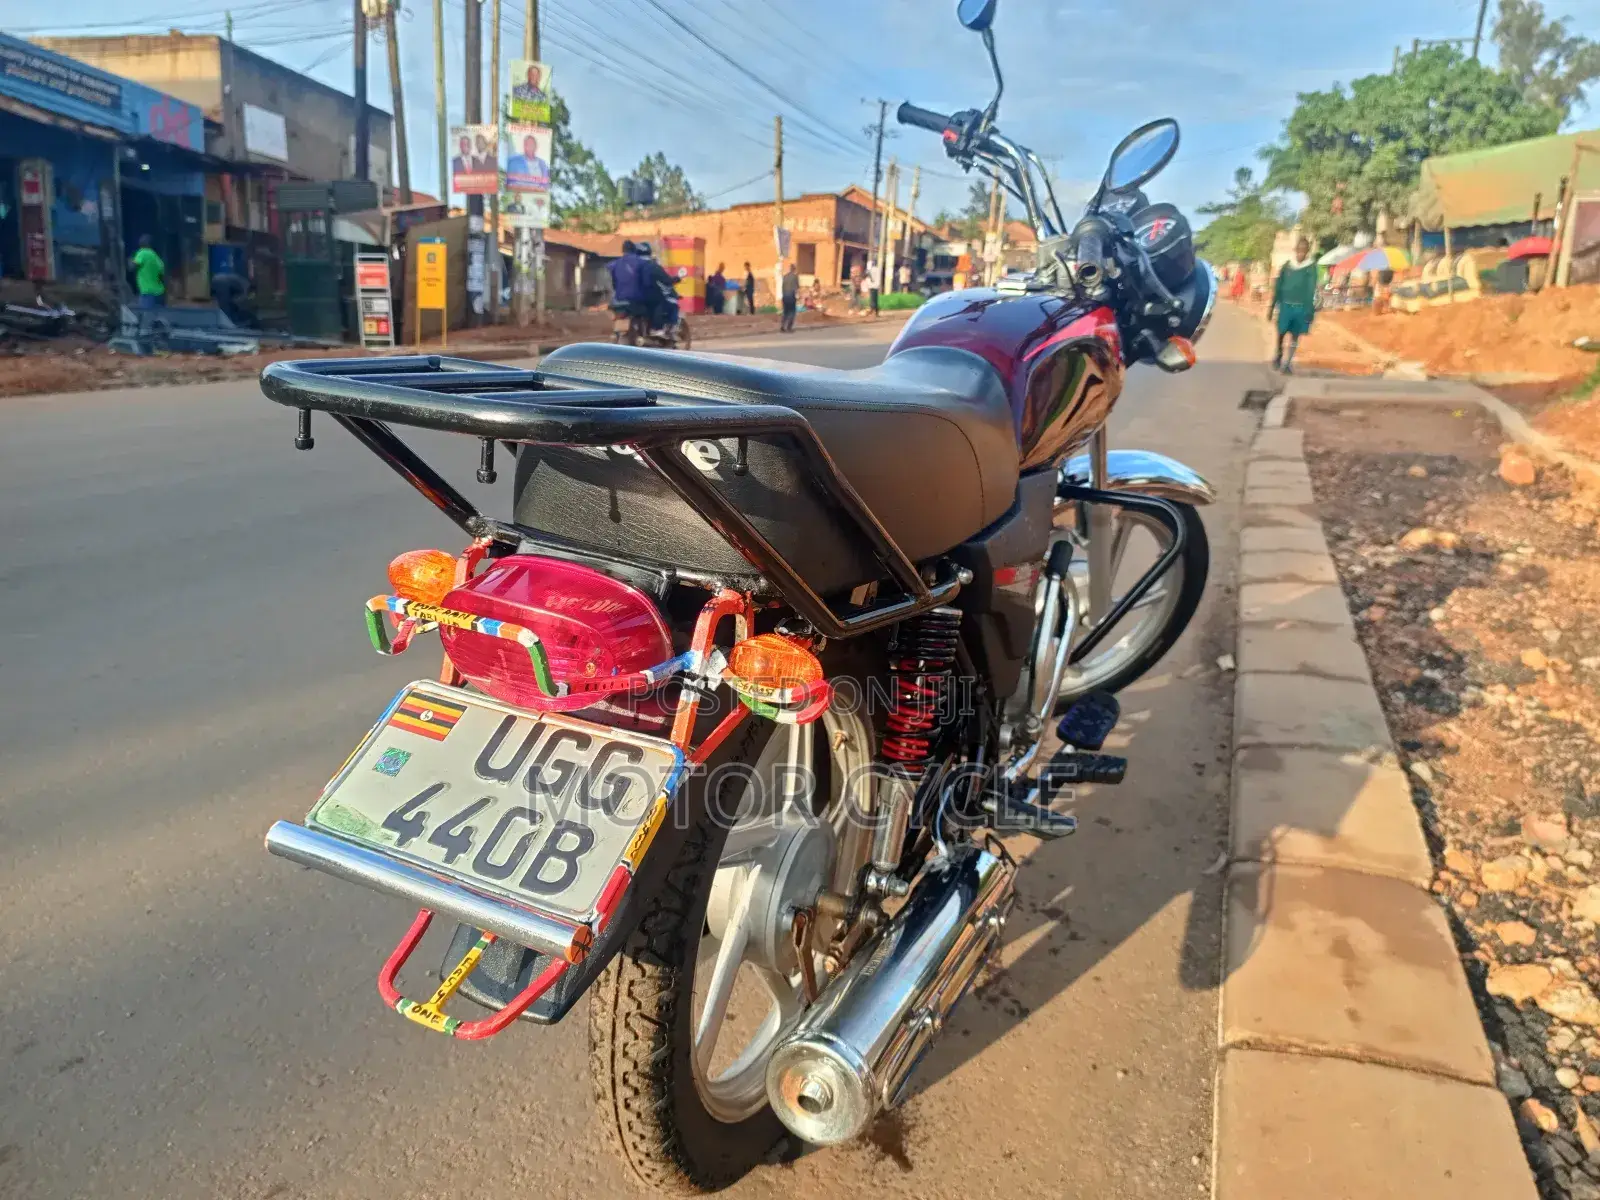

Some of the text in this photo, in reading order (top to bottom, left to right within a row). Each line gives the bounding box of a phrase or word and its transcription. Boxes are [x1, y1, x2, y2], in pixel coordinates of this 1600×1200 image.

[474, 714, 644, 811] UGG
[381, 782, 596, 895] 440B
[411, 1004, 442, 1024] ONE
